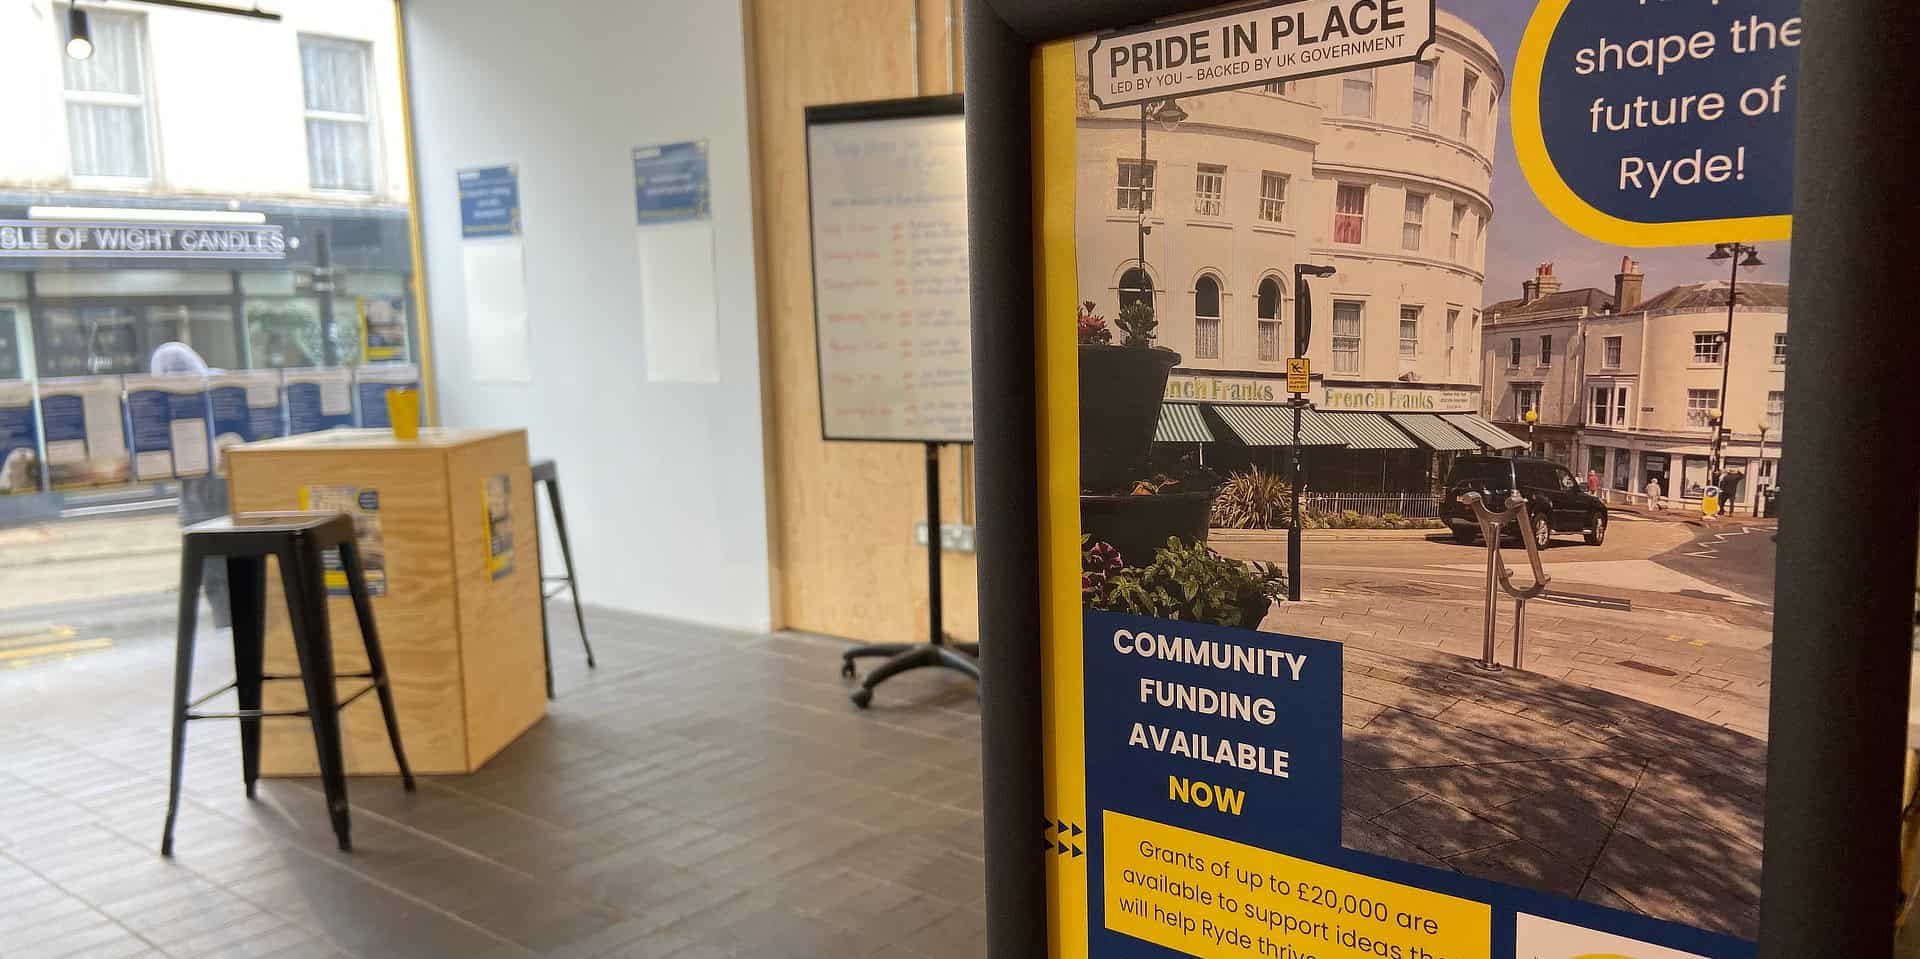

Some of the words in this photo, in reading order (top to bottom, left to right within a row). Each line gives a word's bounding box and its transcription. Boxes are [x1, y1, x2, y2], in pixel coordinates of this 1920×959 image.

[1110, 30, 1211, 78] PRIDE
[1223, 21, 1258, 58] IN
[1271, 0, 1406, 51] PLACE
[1110, 80, 1133, 95] LED
[1136, 77, 1152, 91] BY
[1156, 72, 1182, 87] YOU
[1197, 61, 1250, 81] BACKED
[1254, 57, 1272, 72] BY
[1277, 53, 1297, 68] UK
[1300, 34, 1405, 63] GOVERNMENT
[1575, 30, 1716, 76] shape
[1730, 15, 1802, 53] the
[1590, 91, 1725, 133] future
[1739, 75, 1787, 117] of
[1619, 147, 1746, 199] Ryde!
[0, 226, 48, 250] SLE
[55, 227, 88, 250] OF
[95, 227, 174, 251] WIGHT
[181, 229, 285, 252] CANDLES
[1166, 376, 1208, 399] nch
[1212, 379, 1274, 401] Franks
[1325, 387, 1386, 409] French
[1390, 390, 1434, 409] Franks
[1113, 629, 1307, 681] COMMUNITY
[1140, 678, 1276, 725] FUNDING
[1128, 722, 1289, 778] AVAILABLE
[1169, 775, 1246, 816] NOW
[1123, 868, 1213, 905] available
[1218, 892, 1238, 913] to
[1245, 903, 1329, 941] support
[1336, 924, 1402, 959] ideas
[1139, 840, 1205, 872] Grants
[1210, 861, 1230, 879] of
[1236, 868, 1263, 892] up
[1269, 874, 1291, 896] to
[1297, 882, 1389, 922] £20,000
[1397, 912, 1439, 935] are
[1119, 897, 1148, 919] will
[1154, 904, 1196, 936] help
[1202, 919, 1252, 949] Ryde
[1258, 936, 1316, 959] thriv
